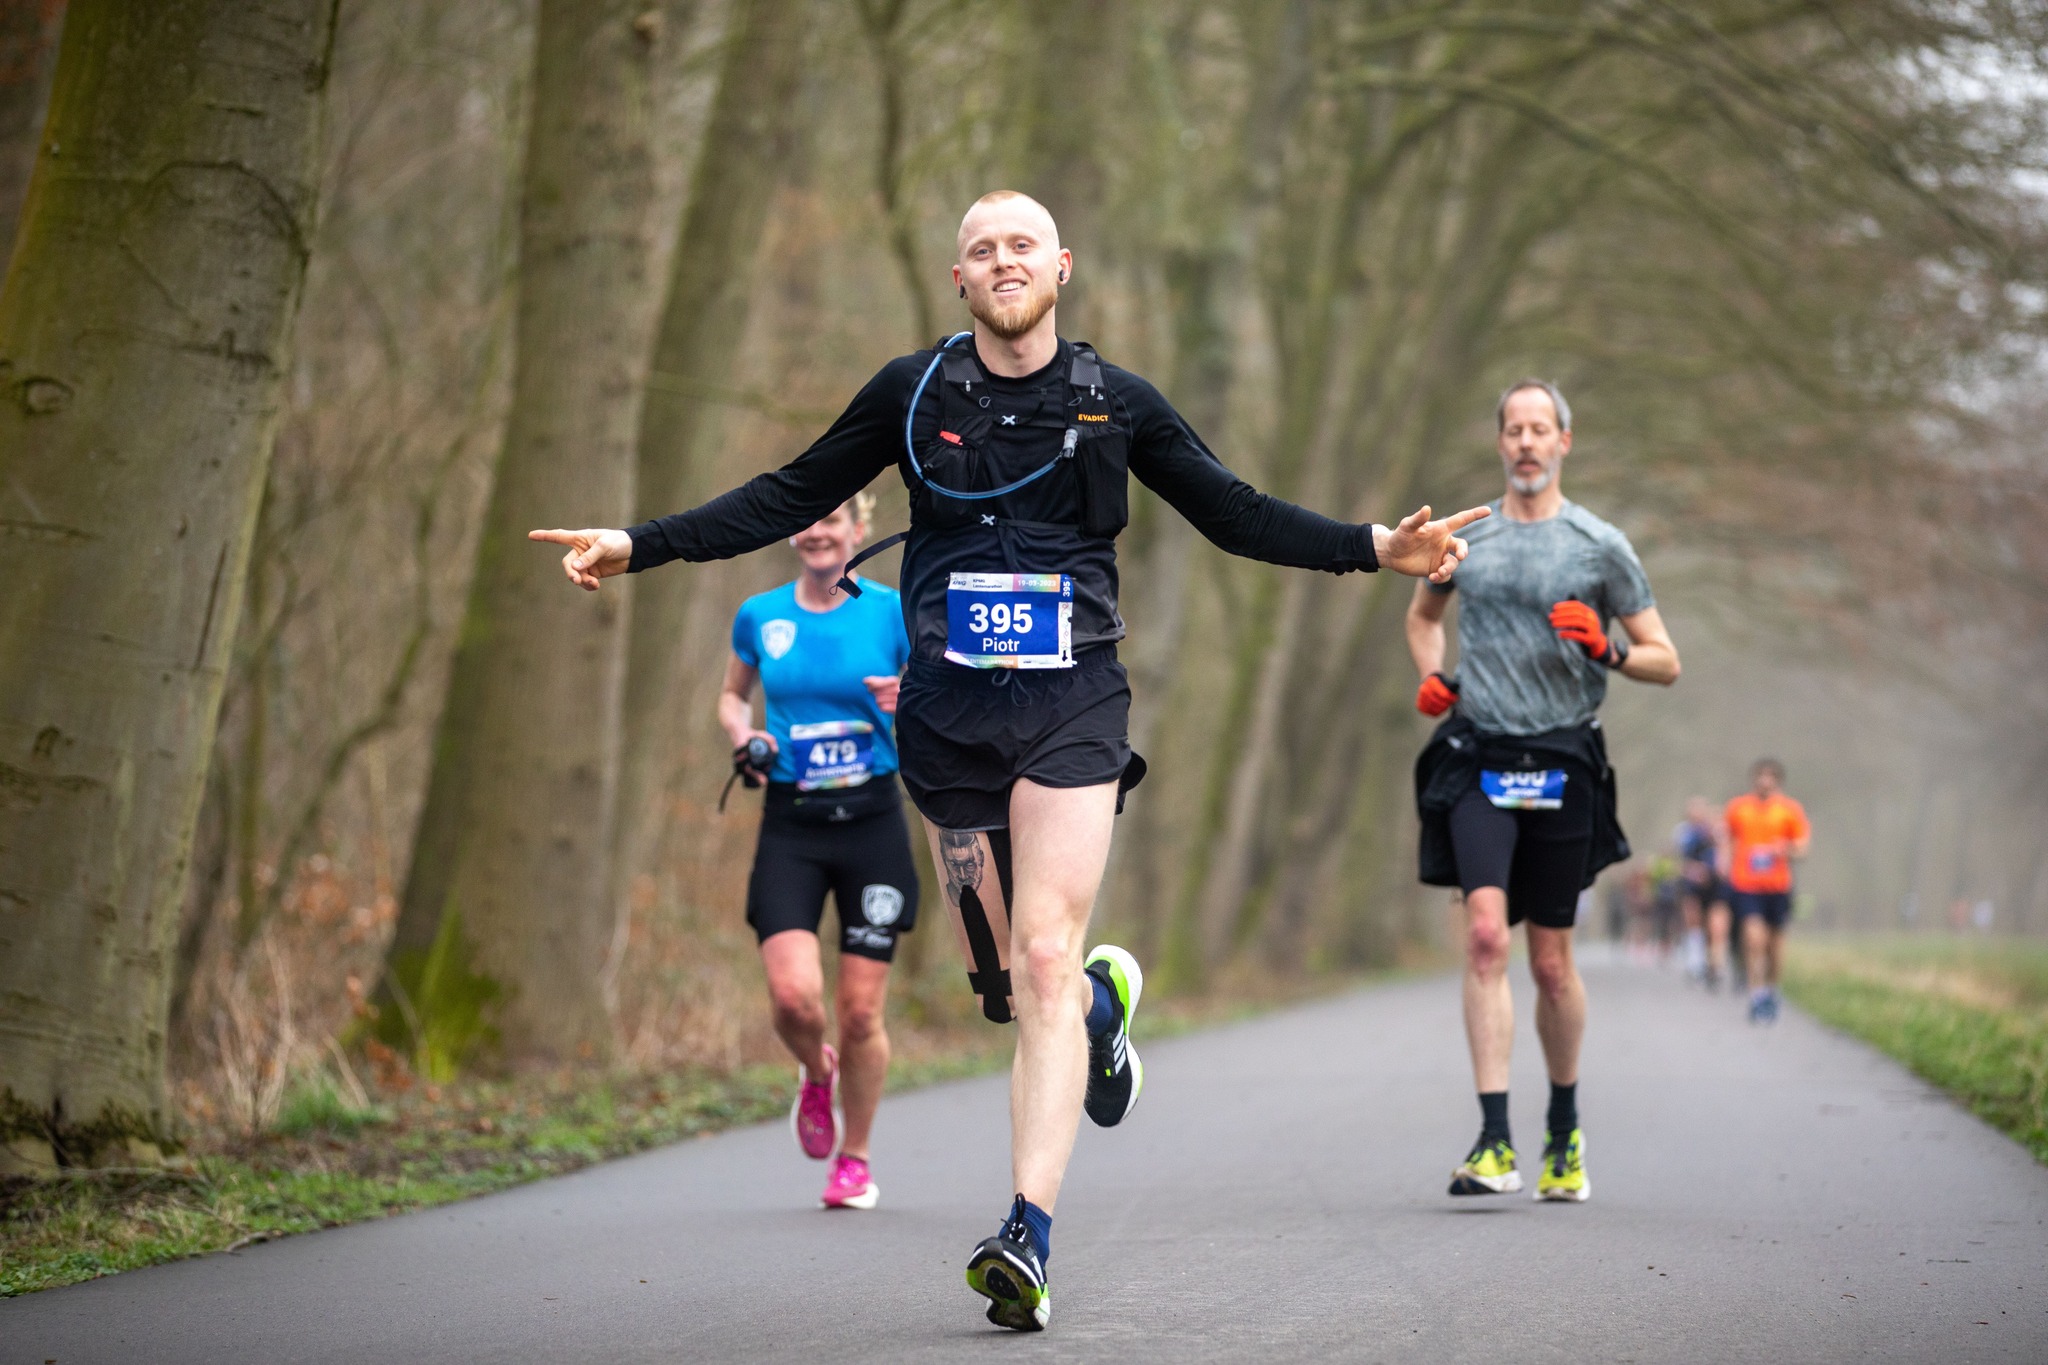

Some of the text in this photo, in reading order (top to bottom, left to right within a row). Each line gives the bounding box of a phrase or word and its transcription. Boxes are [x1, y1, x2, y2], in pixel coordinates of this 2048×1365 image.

[1078, 414, 1109, 422] EVADICT
[1018, 579, 1056, 587] 19-03-2023
[1062, 581, 1071, 597] 395
[969, 603, 1033, 634] 395
[983, 637, 1020, 652] Piotr
[809, 739, 858, 766] 479
